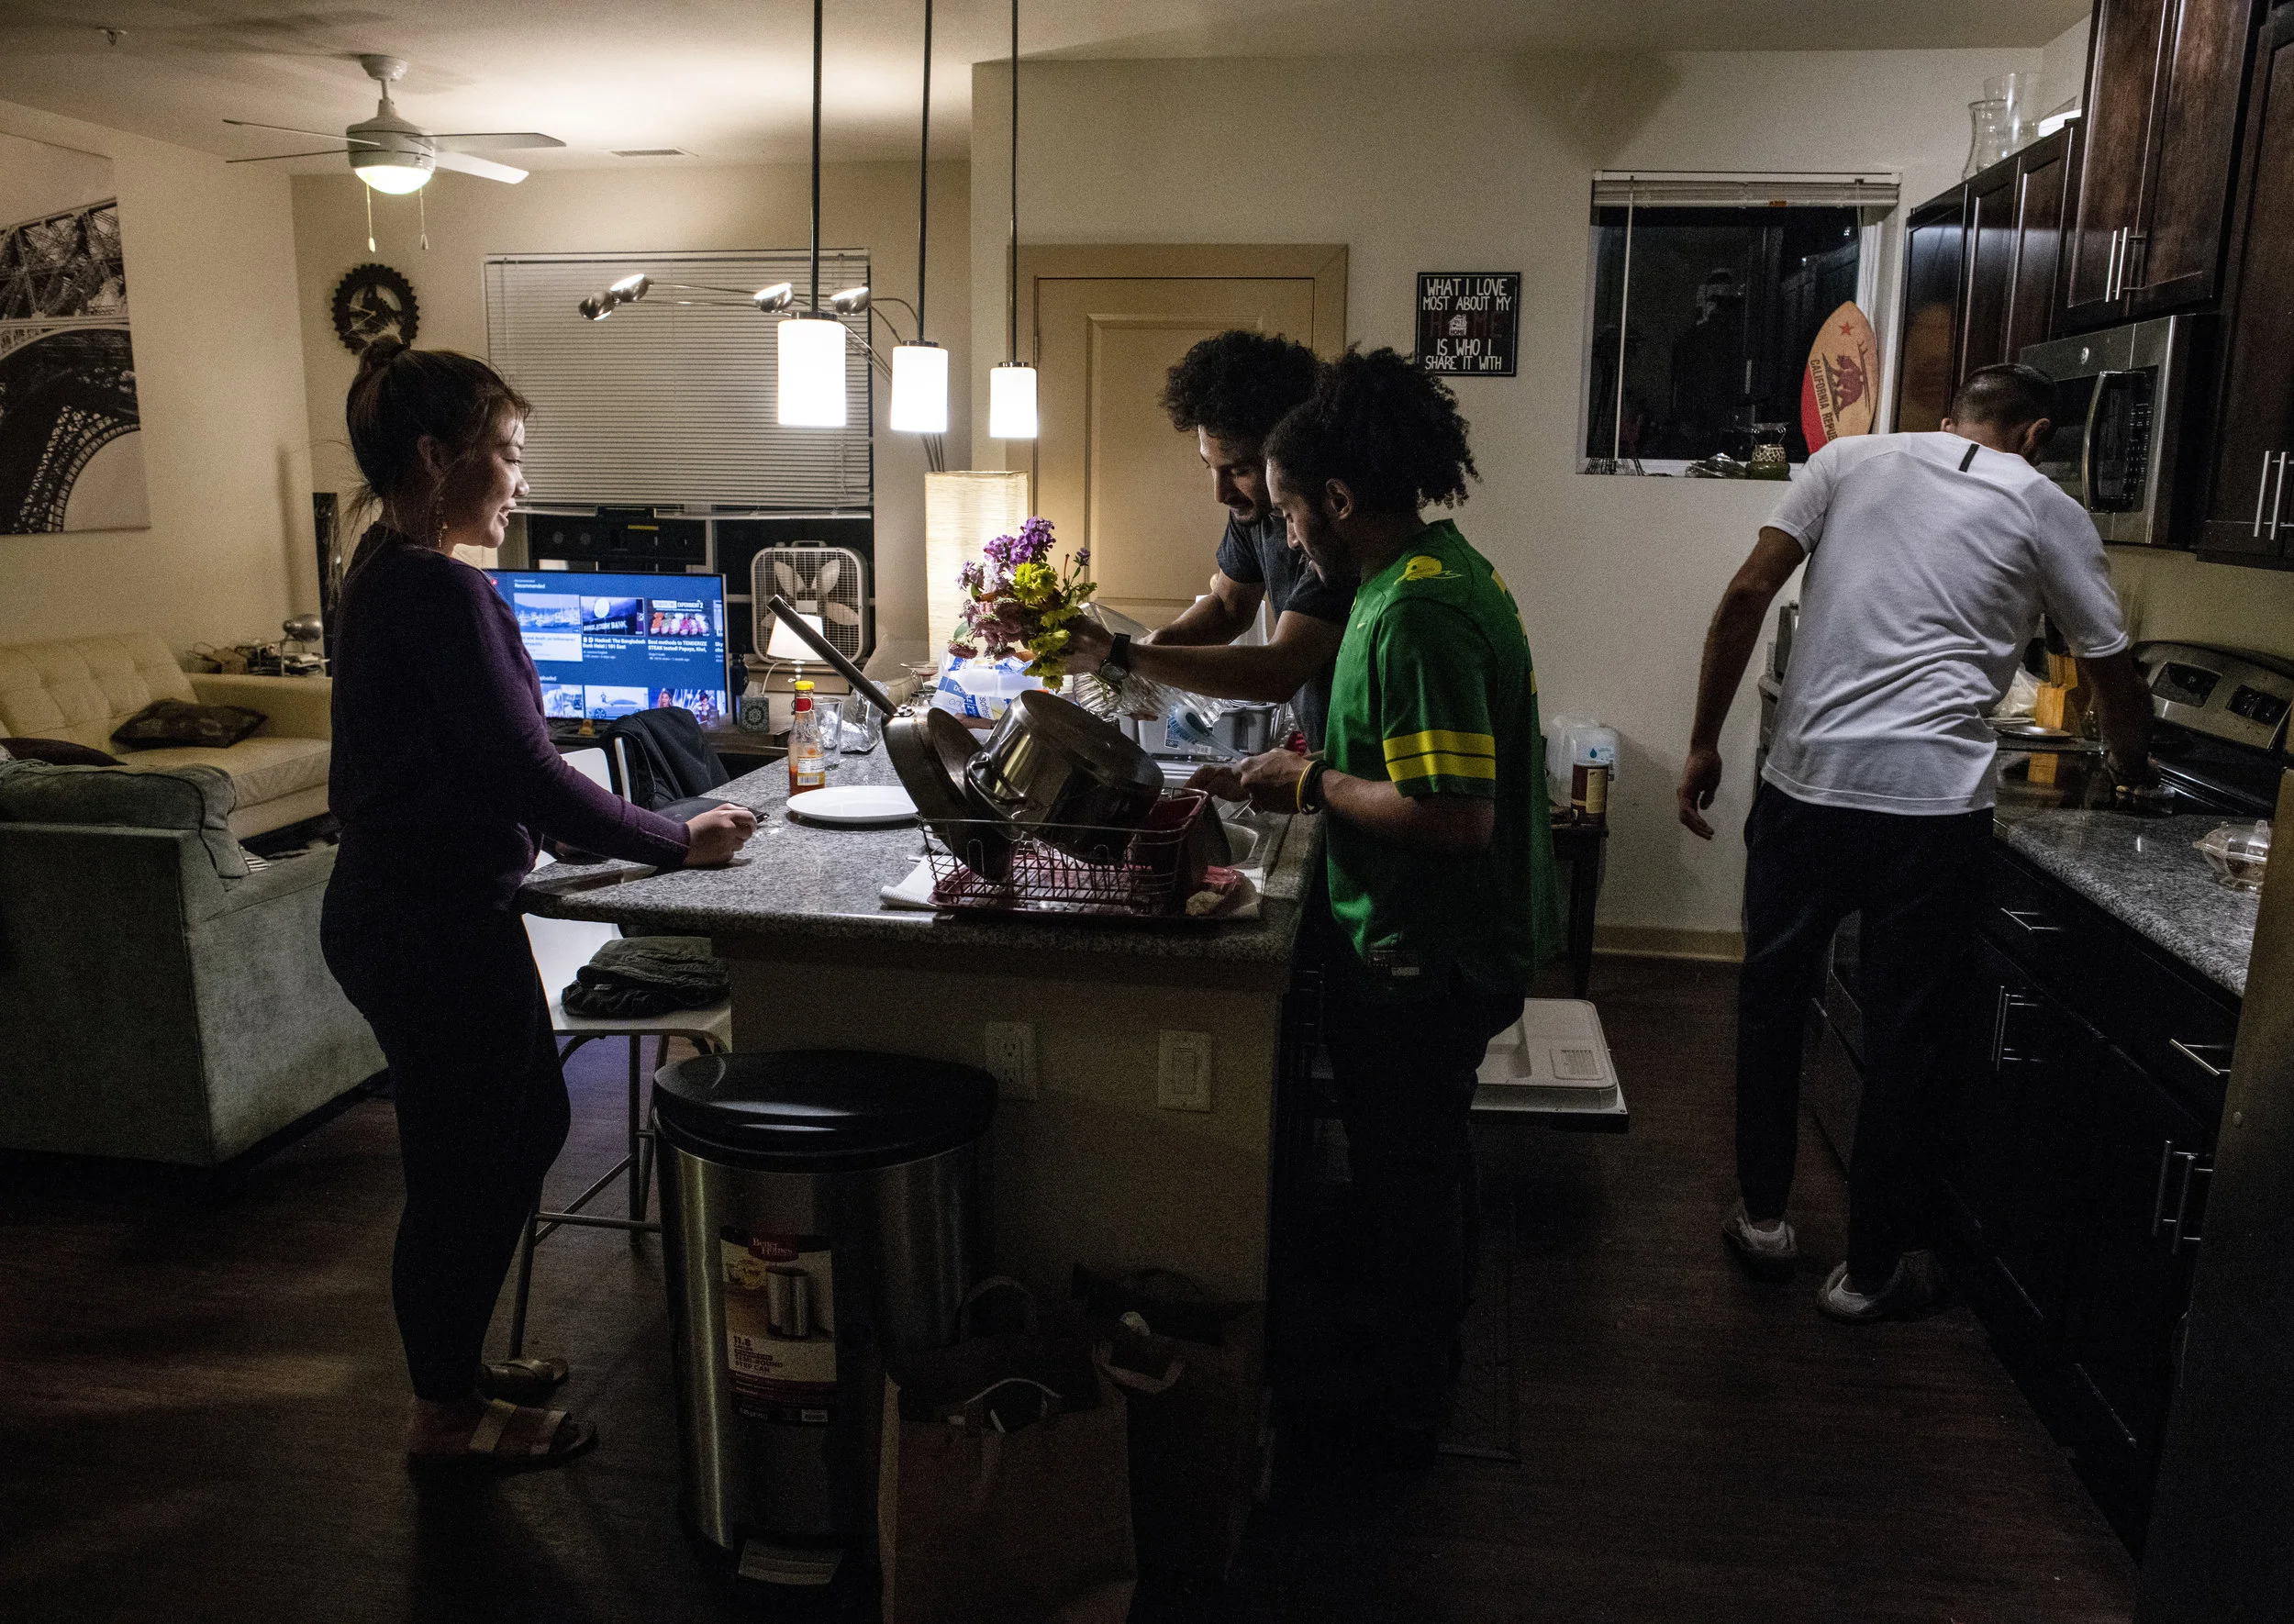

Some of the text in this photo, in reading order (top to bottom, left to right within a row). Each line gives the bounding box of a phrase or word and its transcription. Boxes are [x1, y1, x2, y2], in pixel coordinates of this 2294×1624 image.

[1426, 278, 1508, 296] WHAT I LOVE
[1422, 295, 1512, 311] MOST ABOUT MY
[1437, 339, 1492, 356] IS WHO I
[1424, 355, 1502, 371] SHARE IT WITH
[1810, 359, 1831, 410] CALIFORNIA
